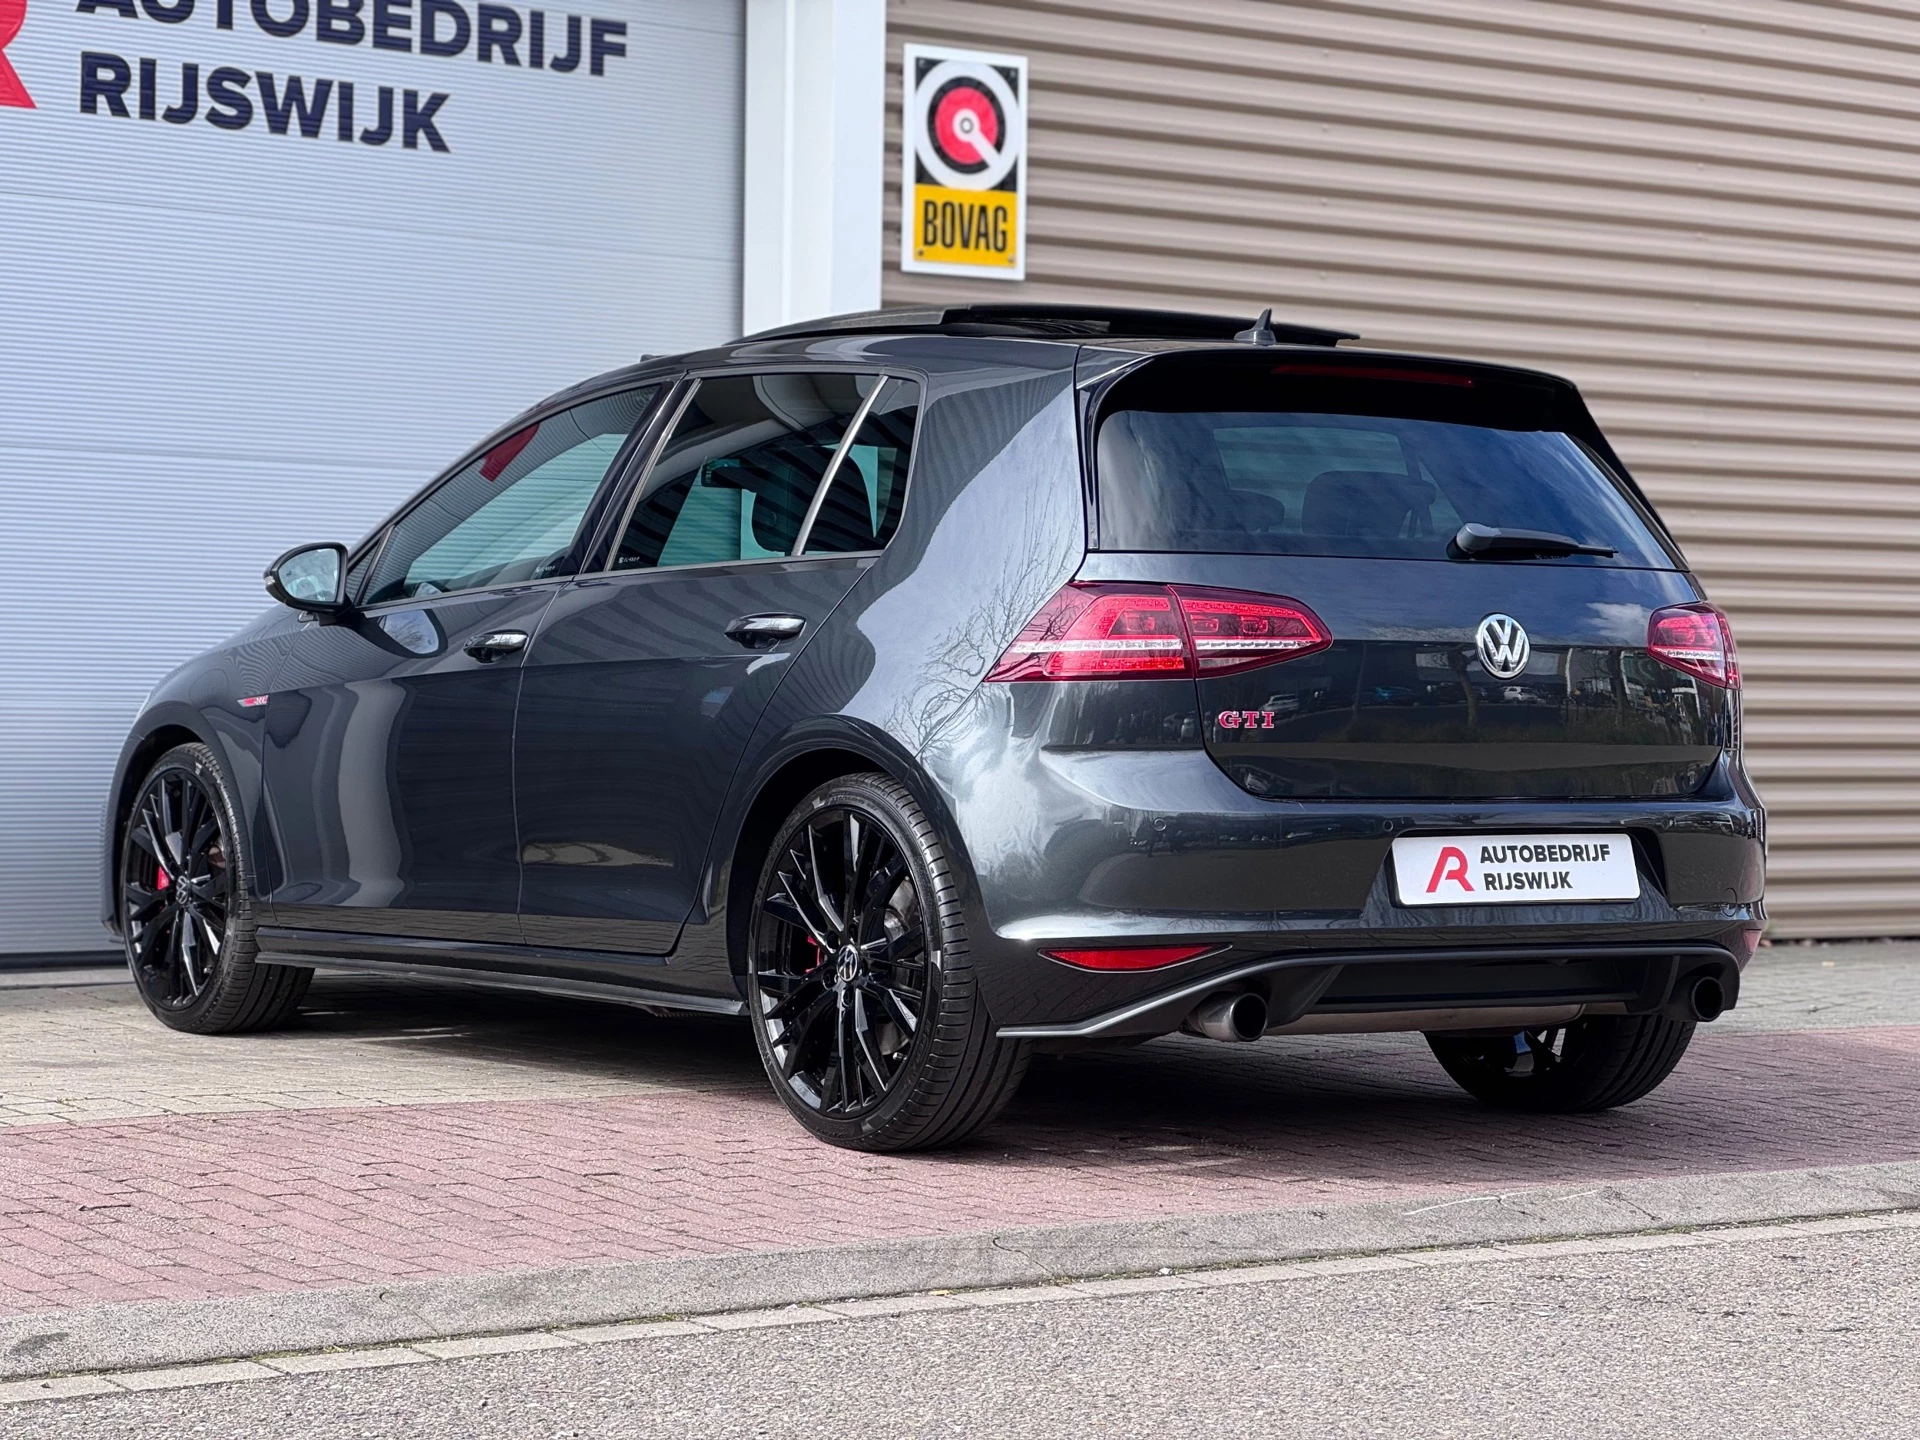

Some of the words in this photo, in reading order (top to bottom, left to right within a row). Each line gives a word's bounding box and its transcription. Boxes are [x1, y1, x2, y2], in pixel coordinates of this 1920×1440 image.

[76, 0, 627, 77] OBEDRIJF
[80, 51, 451, 153] RIJSWIJK
[923, 200, 1008, 253] BOVAG
[1218, 710, 1275, 729] GTI
[1480, 844, 1610, 863] AUTOBEDRIJF
[1483, 871, 1573, 891] RIJSWIJK
